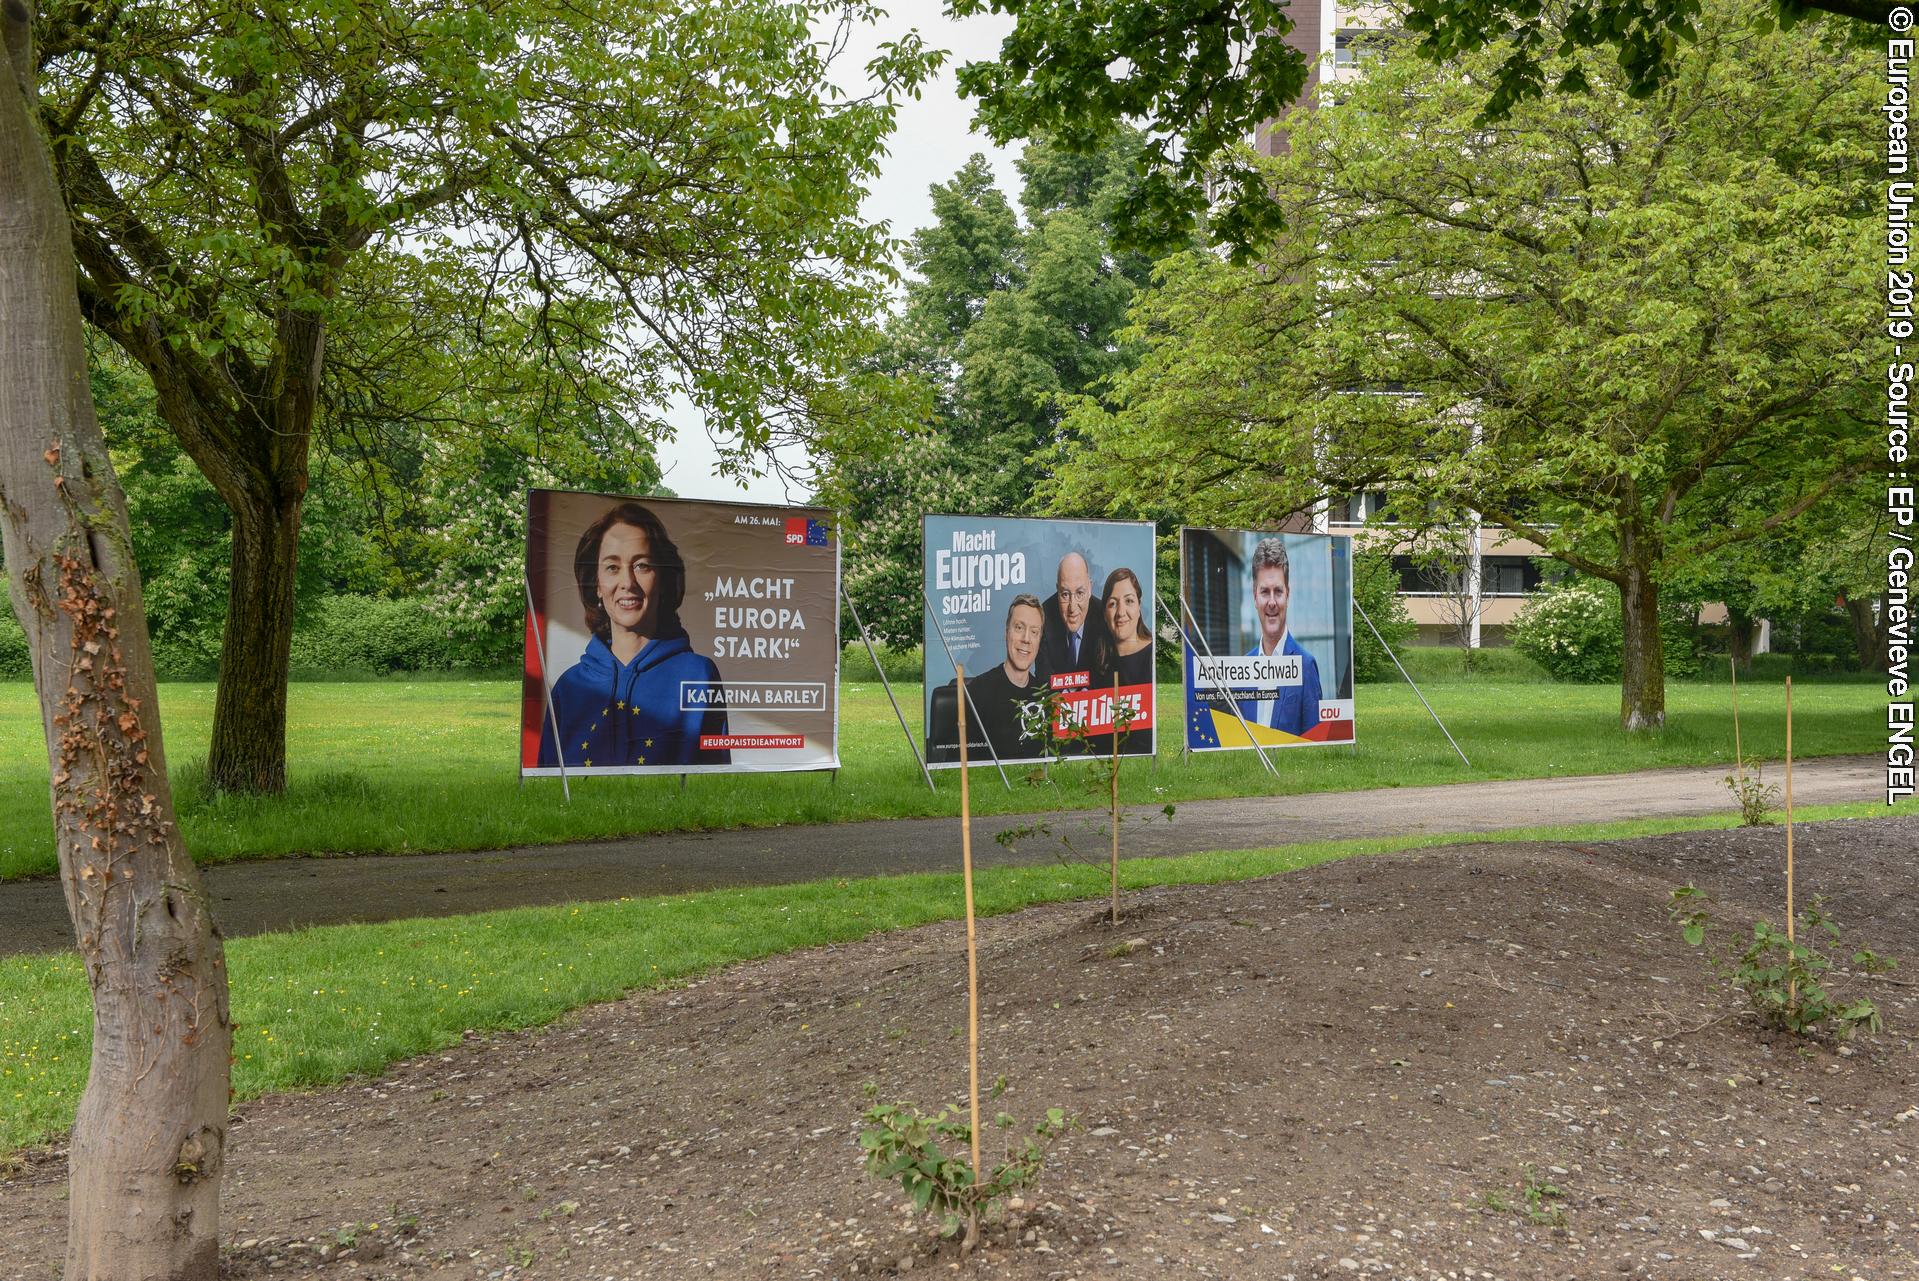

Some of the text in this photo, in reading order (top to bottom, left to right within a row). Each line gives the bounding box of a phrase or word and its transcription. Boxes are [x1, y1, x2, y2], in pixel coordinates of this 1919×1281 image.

[734, 515, 781, 526] AM 26. MAI:
[786, 534, 804, 544] SPD
[952, 529, 996, 552] Macht
[936, 549, 1026, 591] Europa
[942, 588, 991, 615] sozial!
[715, 607, 806, 630] EUROPA
[1198, 659, 1298, 681] Andreas Schwab
[1052, 674, 1088, 687] Am 26. Mai:
[687, 688, 820, 704] KATARINA BARLEY
[1195, 692, 1205, 700] Von
[1206, 692, 1216, 700] uns.
[1261, 690, 1279, 700] Europa.
[1320, 708, 1340, 719] CDU
[703, 737, 802, 747] #EUROPAISTDIEANTWORT
